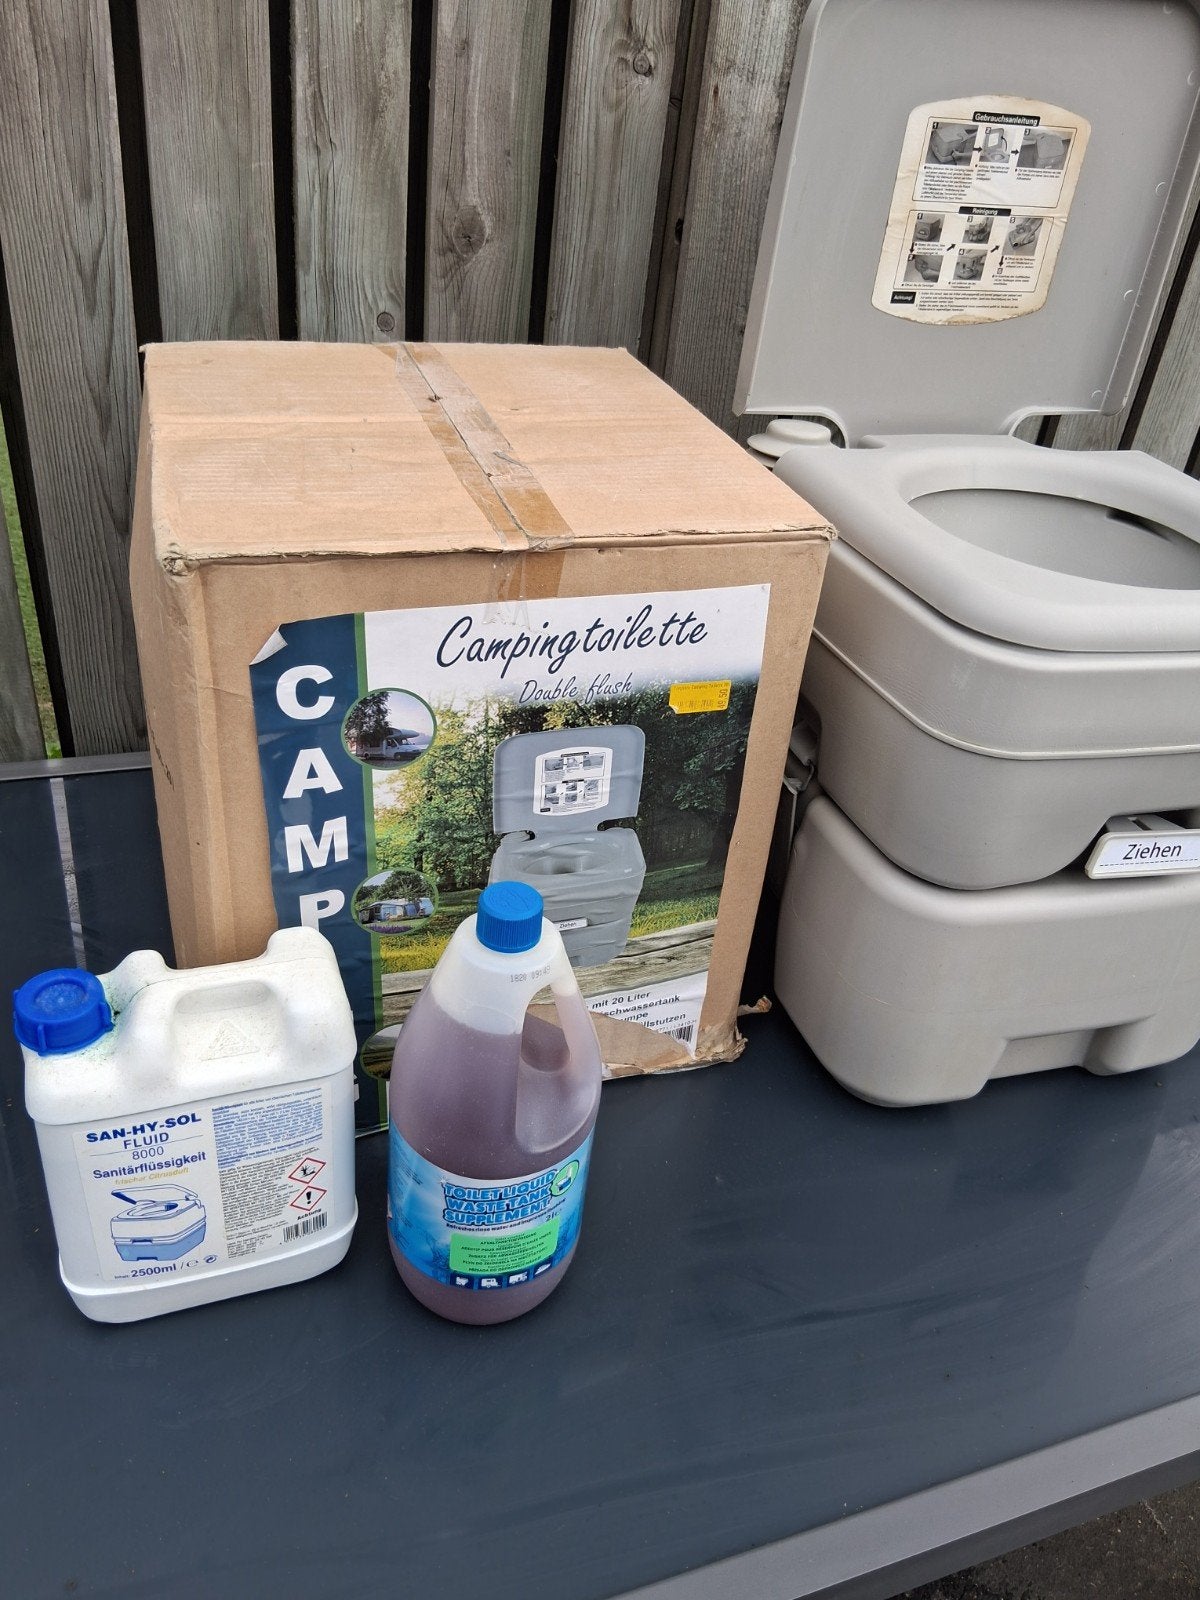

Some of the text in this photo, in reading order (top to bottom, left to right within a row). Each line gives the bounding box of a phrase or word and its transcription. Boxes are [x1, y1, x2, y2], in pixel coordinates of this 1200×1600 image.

[974, 113, 1038, 127] Gebrauchsanleitung
[972, 208, 998, 216] Reinigung
[436, 604, 708, 679] Campingtoilette
[518, 672, 633, 704] Double flush
[1122, 842, 1182, 861] Ziehen
[592, 992, 650, 1009] mit 20 Liter
[641, 1012, 686, 1028] llstutzen
[86, 1112, 202, 1143] SAN-HY-SOL
[123, 1132, 170, 1150] FLUID
[132, 1146, 165, 1161] 8000
[93, 1151, 207, 1179] Sanitärflüssigkeit
[444, 1169, 556, 1200] TOILET LIQUID
[446, 1197, 507, 1212] WASTE
[508, 1186, 551, 1211] TANK
[444, 1196, 550, 1225] SUPPLEMENT
[131, 1263, 177, 1278] 2500ml
